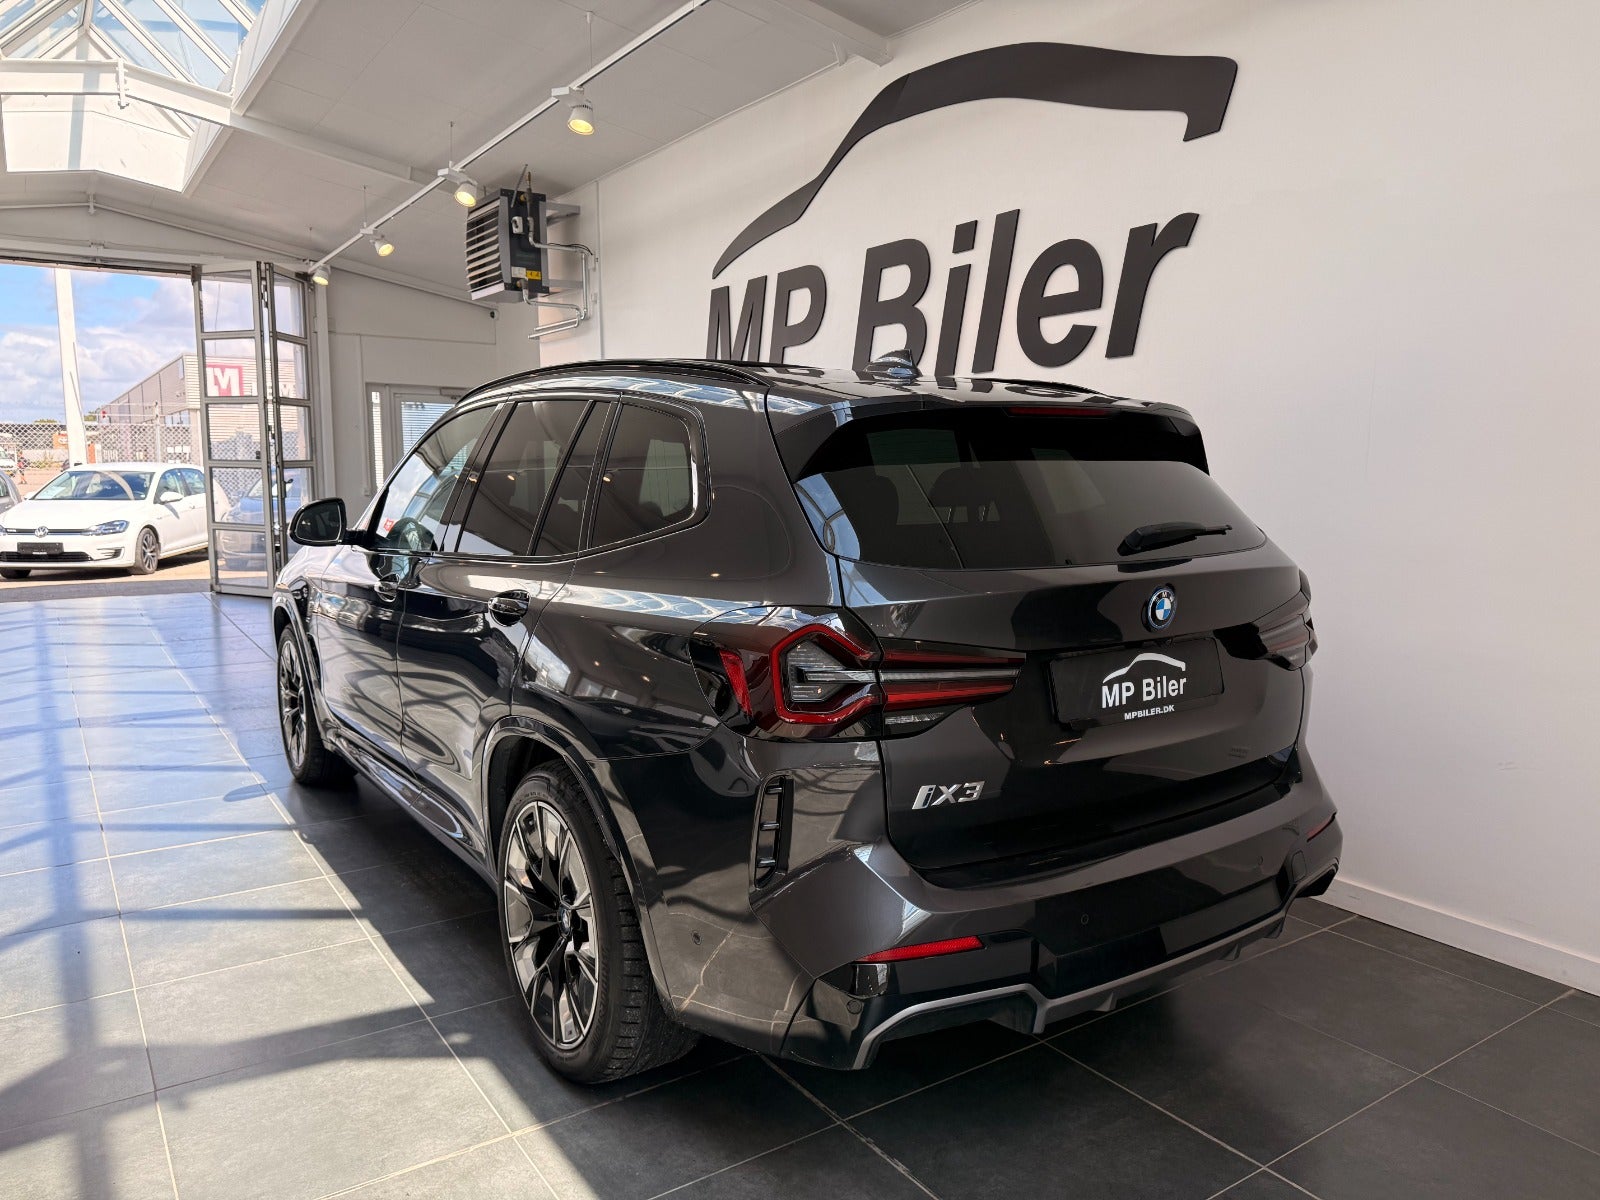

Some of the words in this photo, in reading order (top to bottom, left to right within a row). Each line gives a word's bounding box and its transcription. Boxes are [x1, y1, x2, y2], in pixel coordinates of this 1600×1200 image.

[706, 264, 827, 364] MP
[852, 208, 1200, 377] Biler
[1101, 681, 1135, 709] MP
[1142, 675, 1187, 702] Biler
[1124, 704, 1175, 720] MPBILER.DK
[911, 780, 986, 810] iX3
